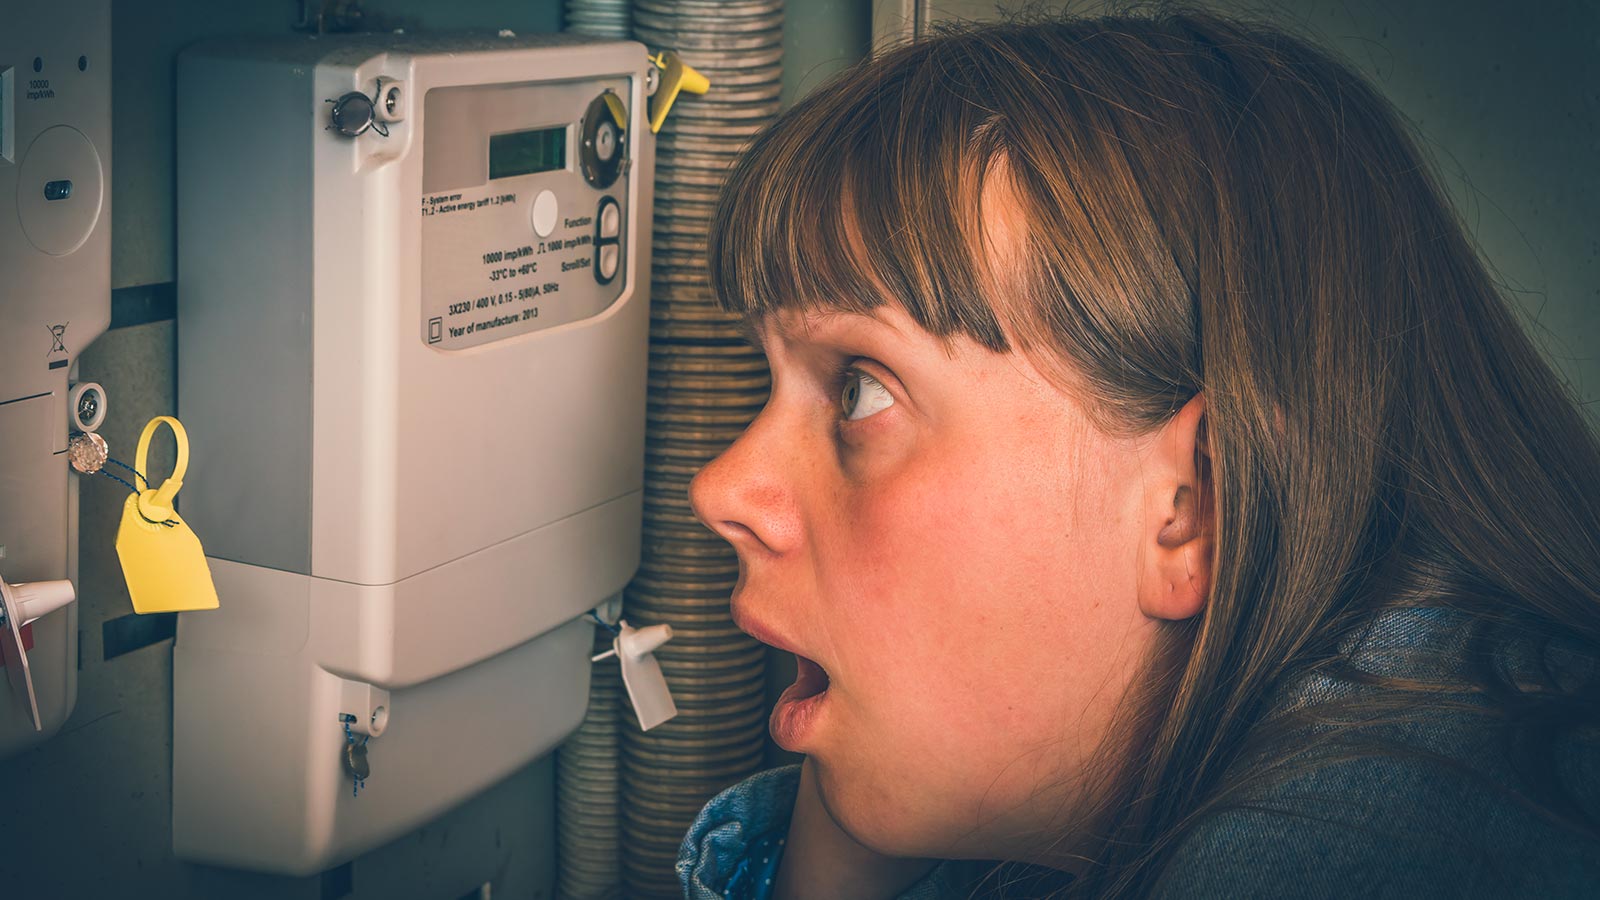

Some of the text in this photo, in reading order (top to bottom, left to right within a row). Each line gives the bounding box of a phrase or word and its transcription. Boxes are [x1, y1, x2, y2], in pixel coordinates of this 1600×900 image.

[29, 80, 49, 89] 10000
[430, 196, 448, 206] System
[439, 205, 456, 213] Active
[458, 202, 475, 210] energy
[564, 217, 592, 228] Function
[483, 235, 591, 264] 10000 imp/kWh 1000 imp/kWh
[509, 268, 516, 277] to
[449, 301, 471, 316] 3X230
[476, 297, 488, 308] 400
[498, 292, 512, 304] 0.15
[543, 282, 559, 294] 50Hz
[449, 307, 538, 338] Year of manufacture: 2013
